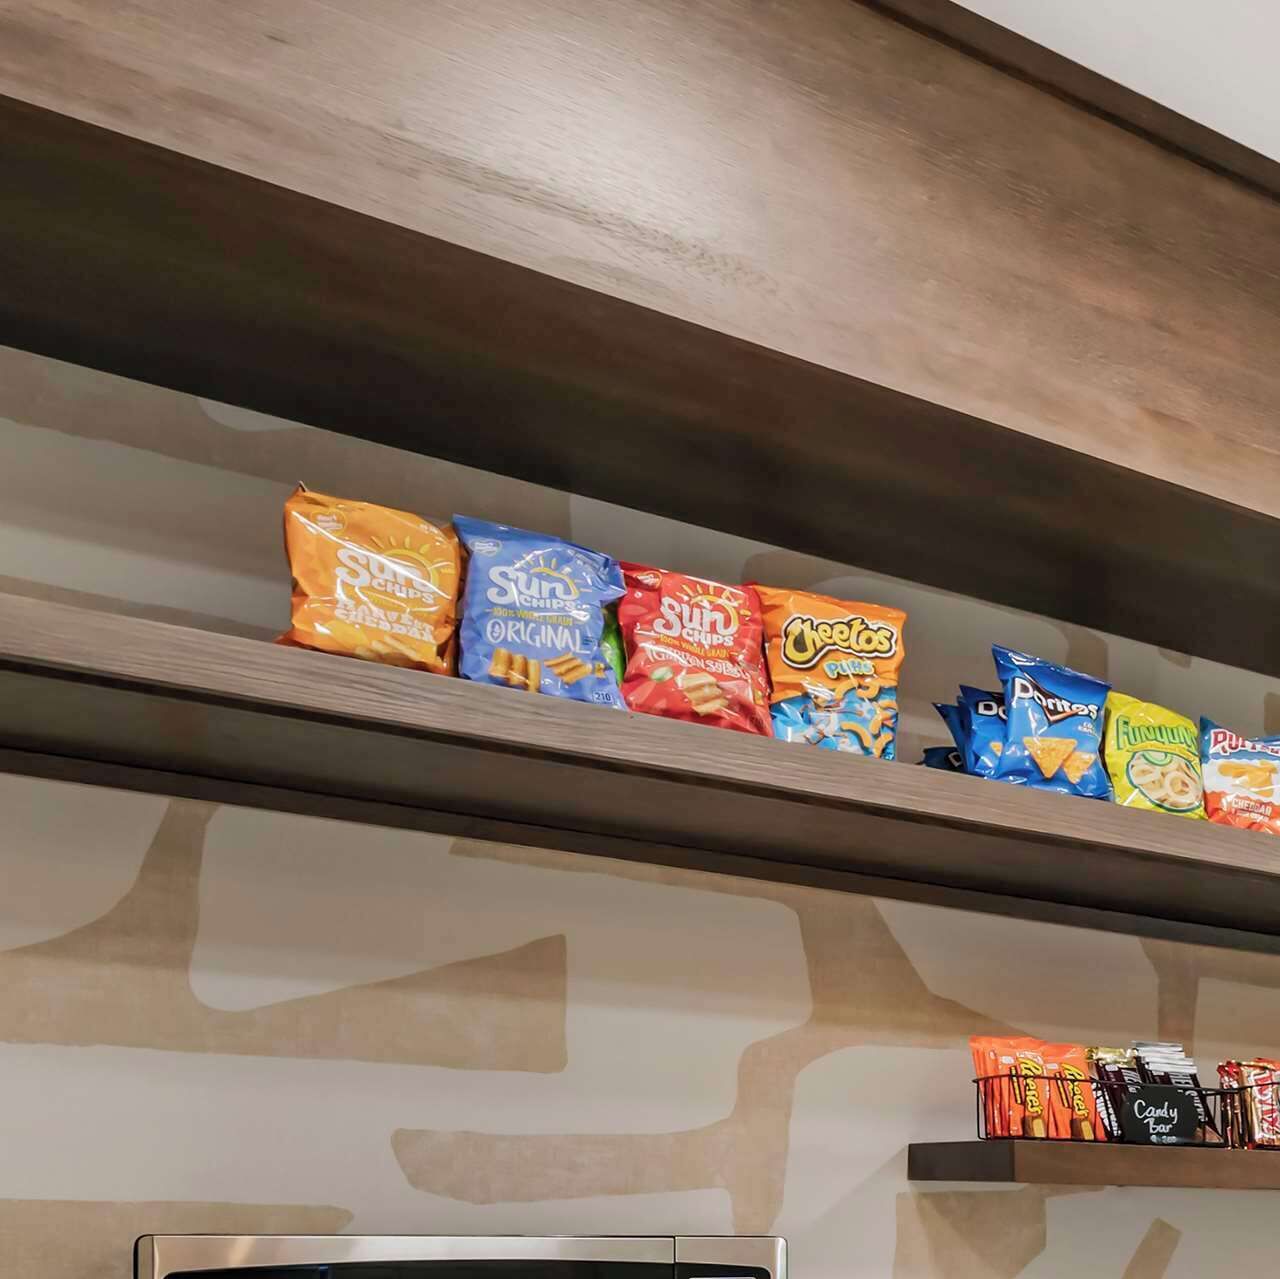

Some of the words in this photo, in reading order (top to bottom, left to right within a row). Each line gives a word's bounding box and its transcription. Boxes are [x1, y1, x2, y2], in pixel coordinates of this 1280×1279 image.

[335, 547, 437, 593] Sun
[487, 565, 581, 605] Sun
[371, 579, 435, 604] CHIPS
[518, 595, 576, 612] CHIPS
[653, 596, 738, 637] Sun
[486, 618, 592, 654] ORIGINAL
[682, 626, 735, 647] CHIPS
[781, 615, 896, 667] Cheetos
[1012, 677, 1099, 720] Doritos
[1231, 797, 1273, 816] CHEDDAR
[1133, 1099, 1178, 1124] Candy
[1143, 1118, 1173, 1134] Bar
